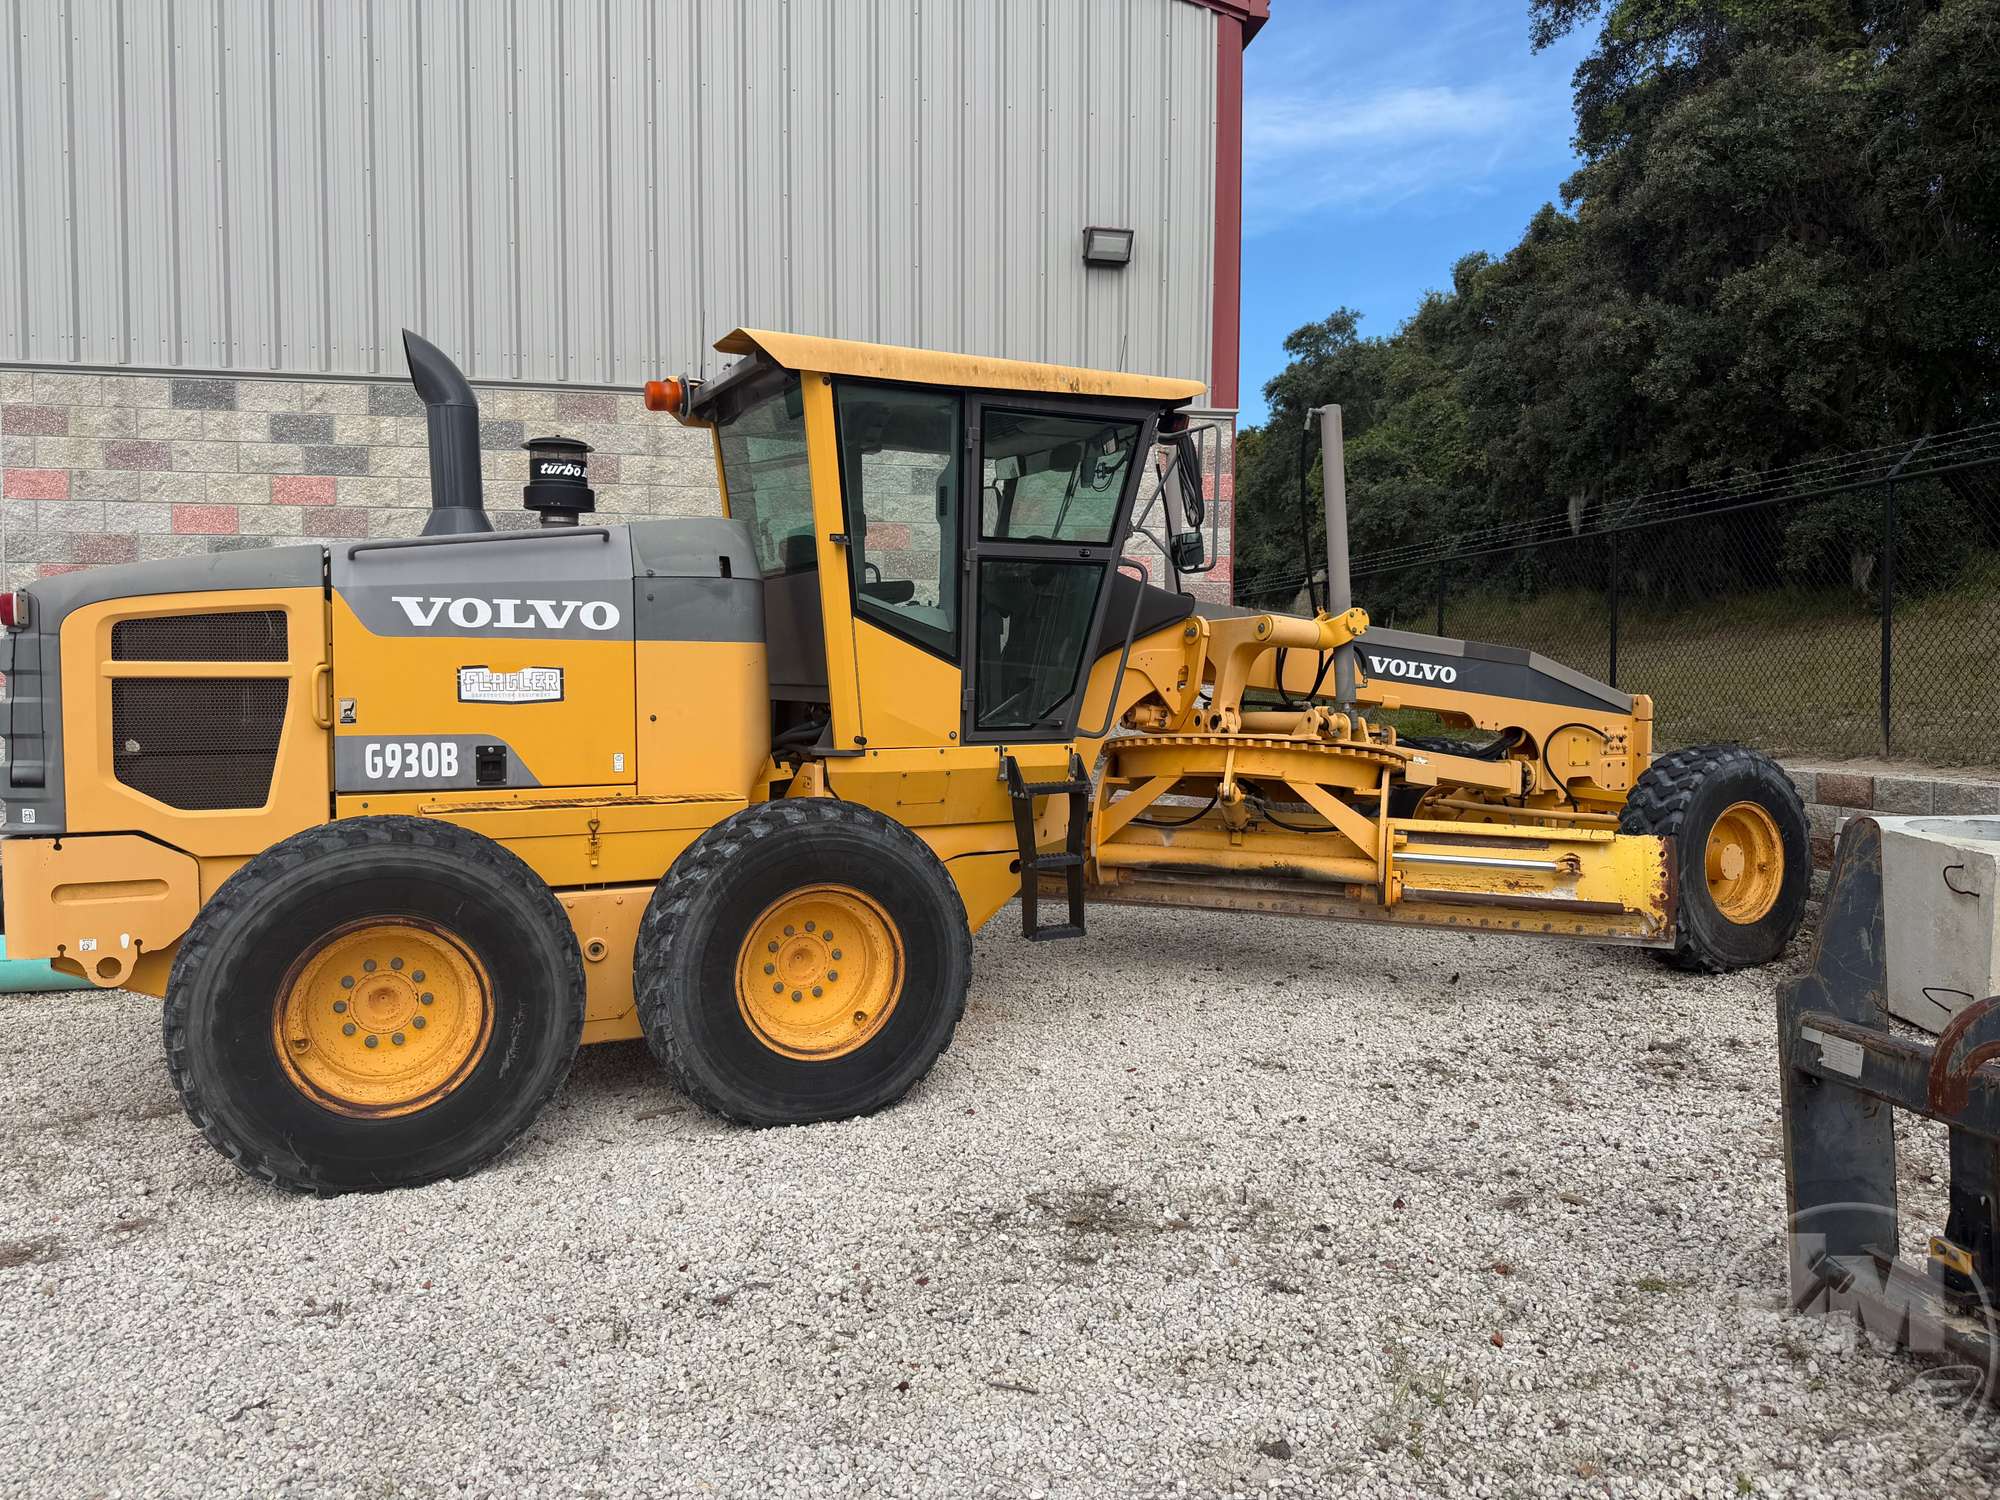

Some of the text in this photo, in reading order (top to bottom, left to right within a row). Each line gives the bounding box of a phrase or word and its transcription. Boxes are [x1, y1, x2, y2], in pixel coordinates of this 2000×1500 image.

[540, 462, 581, 477] turbo
[391, 596, 620, 631] VOLVO
[463, 671, 559, 692] FLAGLER
[1368, 655, 1457, 684] VOLVO
[364, 742, 459, 779] G930B
